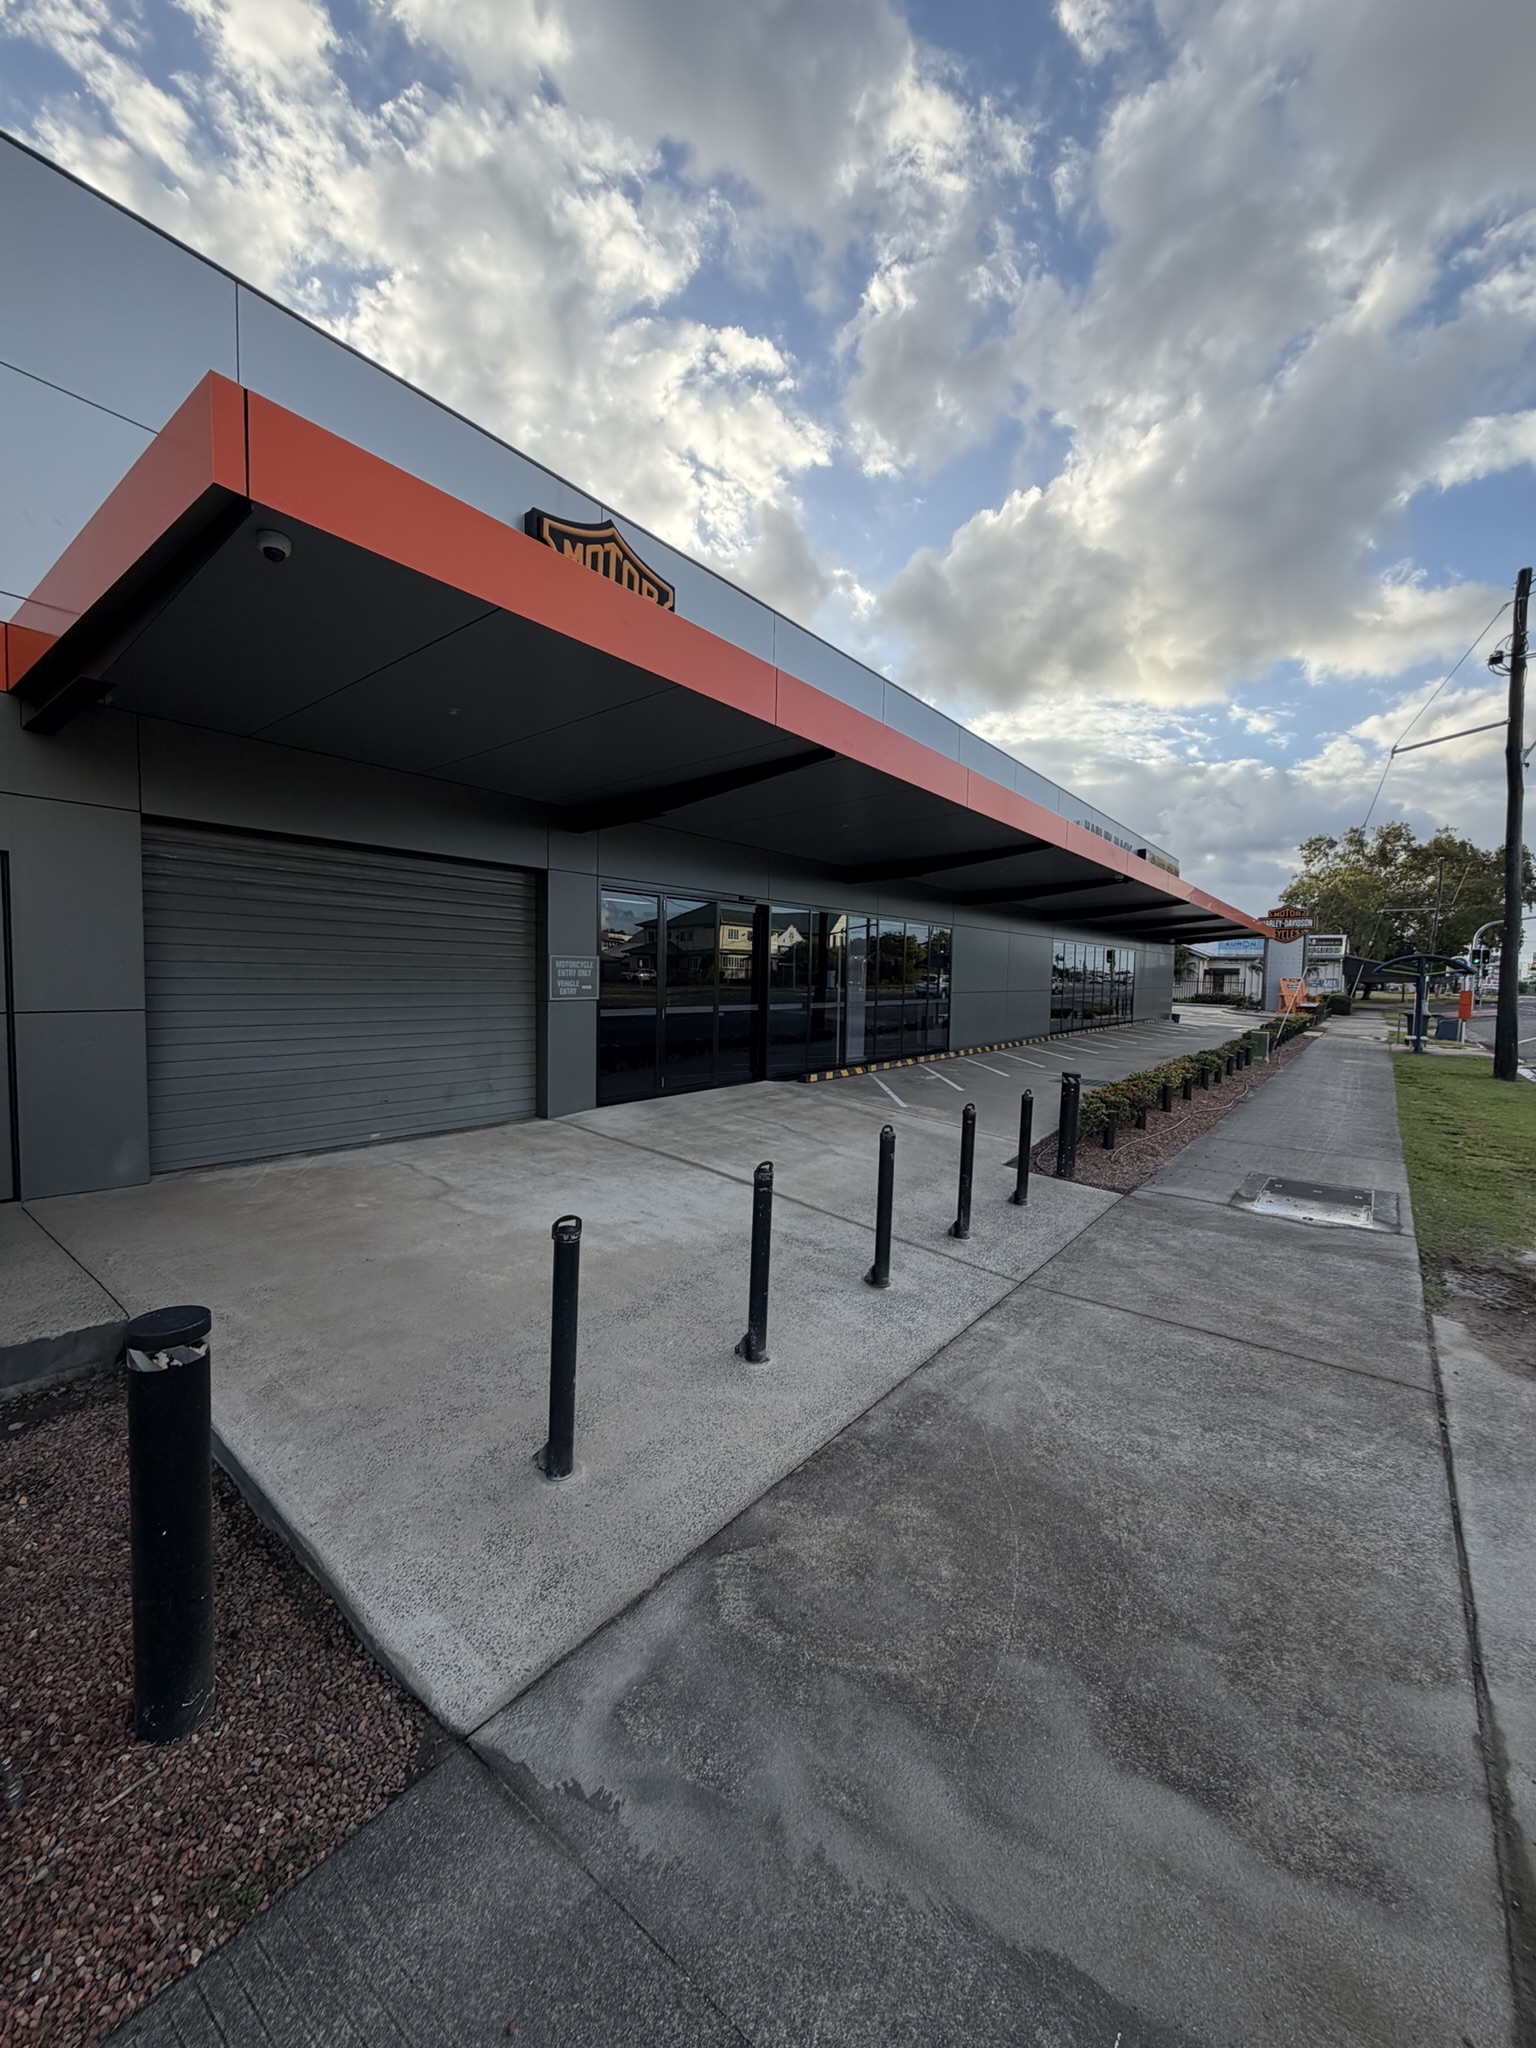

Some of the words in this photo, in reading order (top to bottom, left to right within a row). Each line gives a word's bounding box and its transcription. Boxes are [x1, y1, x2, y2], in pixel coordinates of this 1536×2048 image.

[1273, 909, 1301, 918] MOTOR
[1263, 919, 1313, 928] ARLEY-DAVIDSON
[1276, 929, 1301, 940] YCLES
[555, 960, 594, 968] MOTORCYCLE
